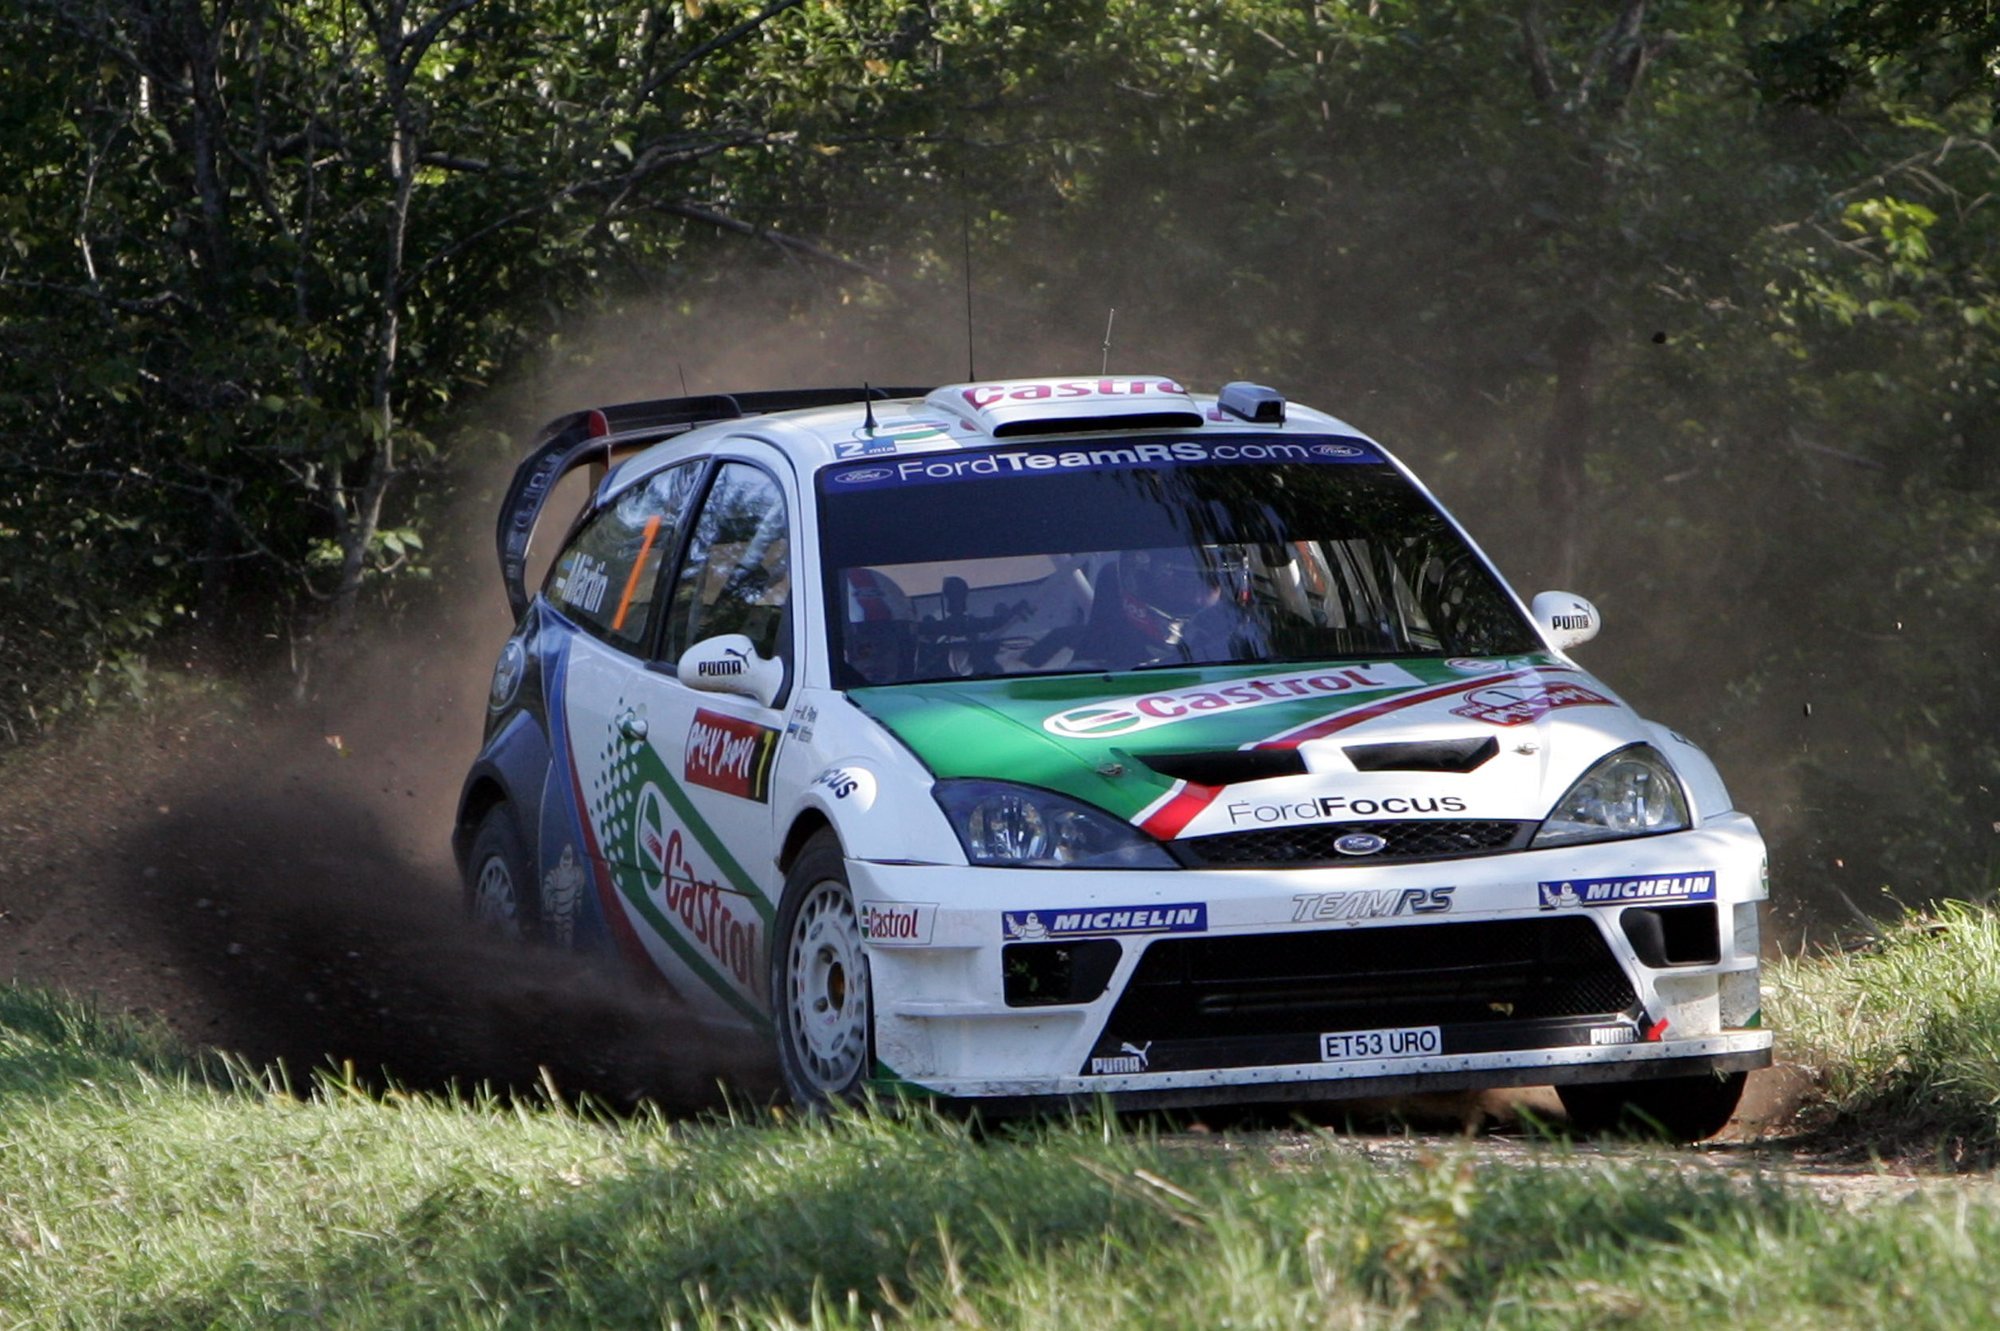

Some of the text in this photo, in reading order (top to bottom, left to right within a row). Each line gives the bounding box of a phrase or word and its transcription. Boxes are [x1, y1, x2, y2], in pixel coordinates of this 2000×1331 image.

[898, 442, 1309, 481] FordTeamRS.com
[1552, 615, 1589, 630] PUMA
[699, 660, 742, 677] PUMA
[1135, 670, 1385, 719] Castrol
[1228, 796, 1467, 825] FordFocus
[1586, 876, 1711, 899] MICHELIN
[664, 829, 761, 1000] Castrol
[870, 906, 919, 938] Castrol
[1053, 908, 1199, 930] MICHELIN
[1326, 1030, 1437, 1058] ET53 URO
[1590, 1026, 1634, 1045] PUMA
[1091, 1057, 1143, 1075] PUMA
